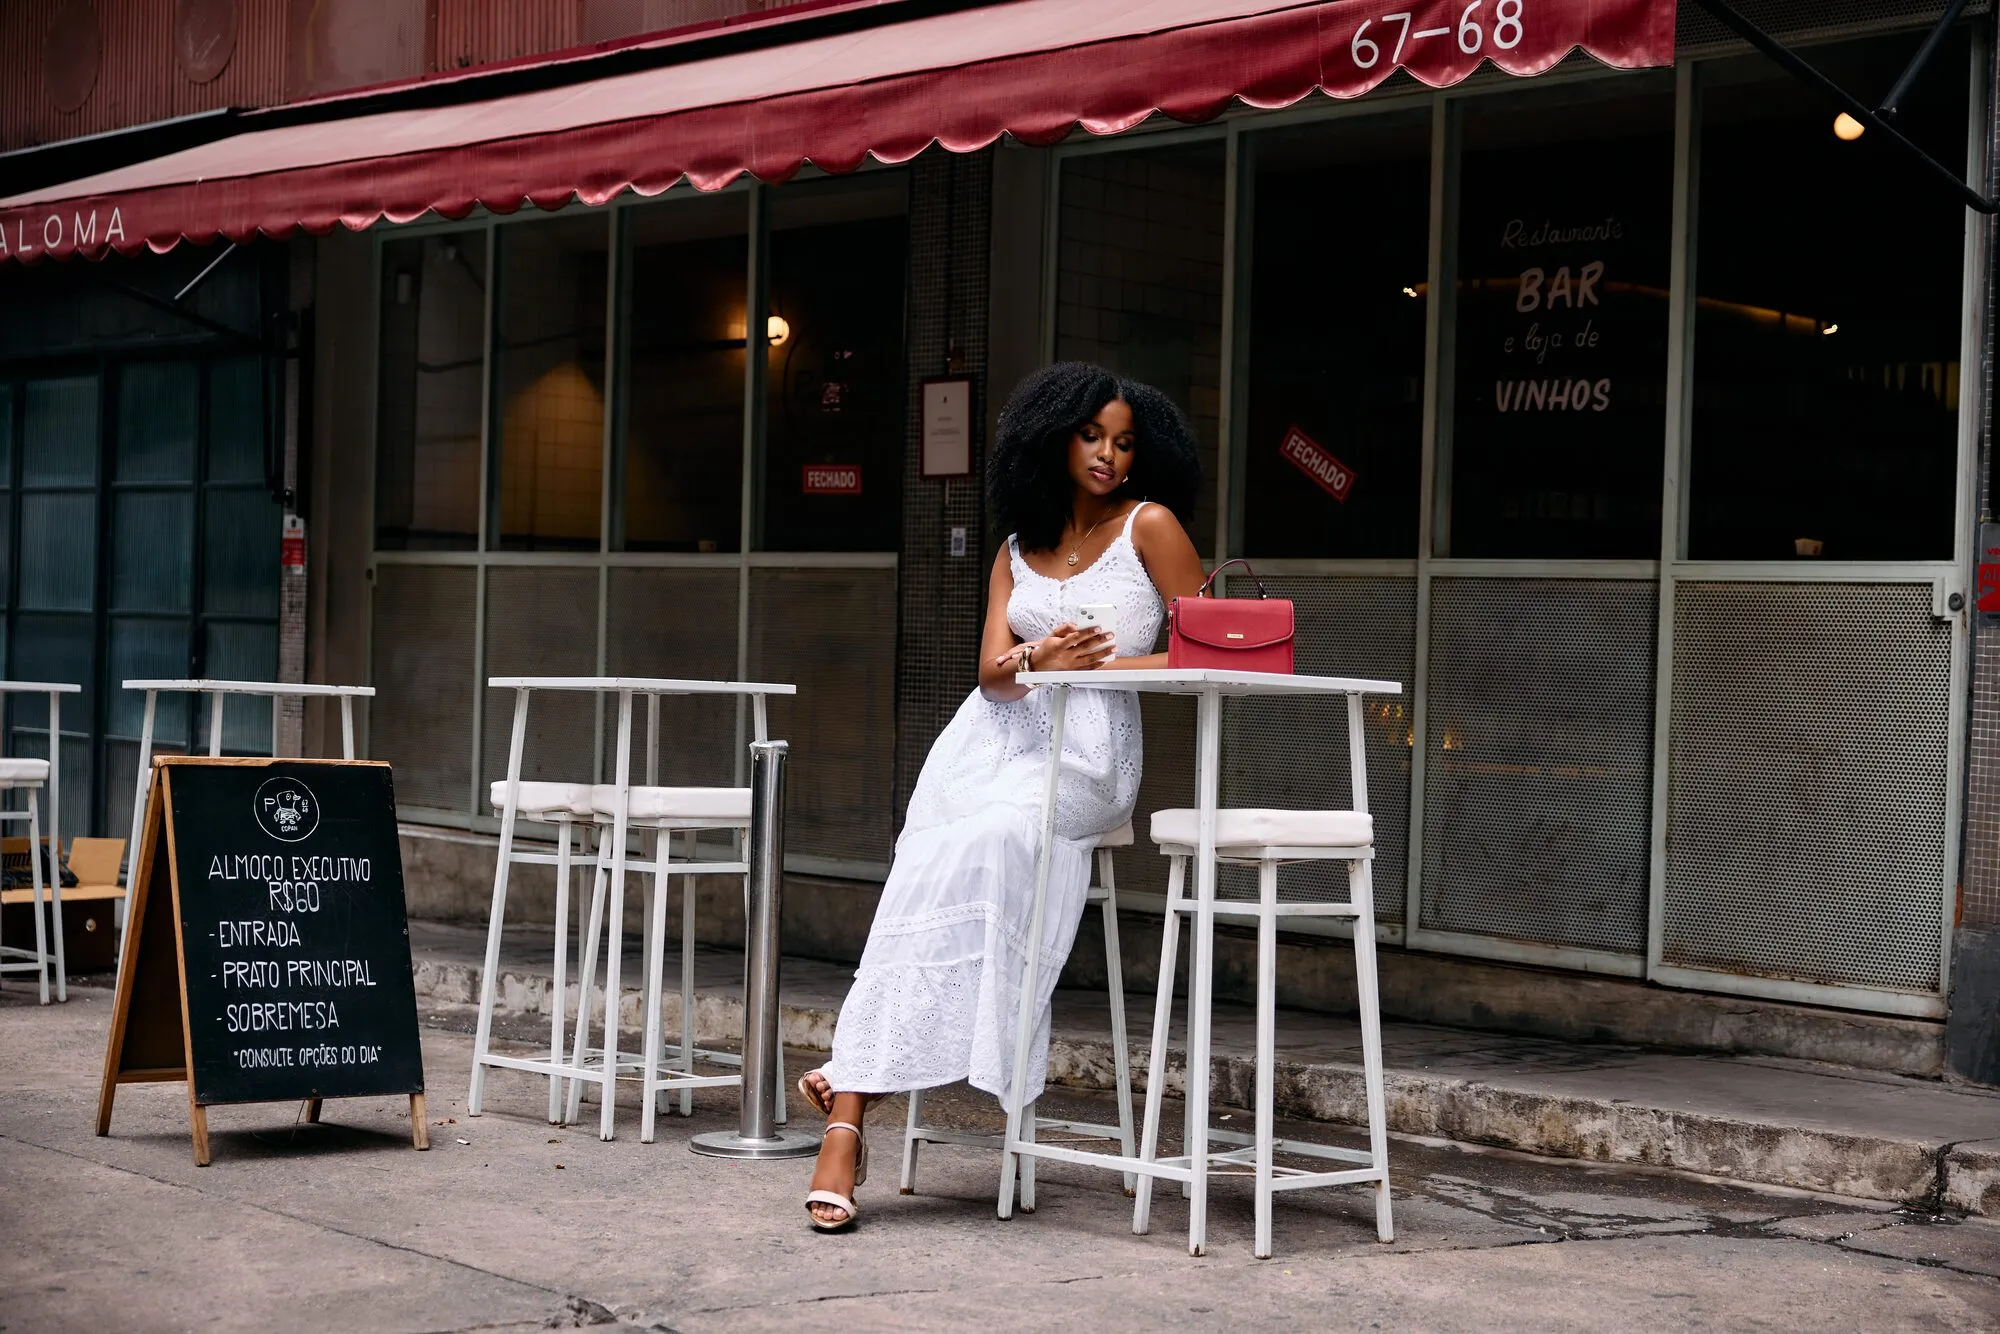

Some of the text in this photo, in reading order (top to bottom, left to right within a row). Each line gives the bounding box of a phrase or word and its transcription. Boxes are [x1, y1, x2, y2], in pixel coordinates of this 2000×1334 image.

[1501, 214, 1623, 249] Restaurante
[1516, 261, 1604, 312] BAR
[1504, 319, 1599, 365] e loja de
[1496, 378, 1611, 412] VINHOS
[1286, 434, 1347, 490] FECHADO
[807, 471, 856, 488] FECHADO
[208, 855, 371, 882] ALMOÇO EXECUTIVO
[268, 880, 320, 913] R$60
[287, 960, 376, 987] PRINCIPAL
[300, 1043, 337, 1068] OPÇÕES
[341, 1046, 356, 1064] DO
